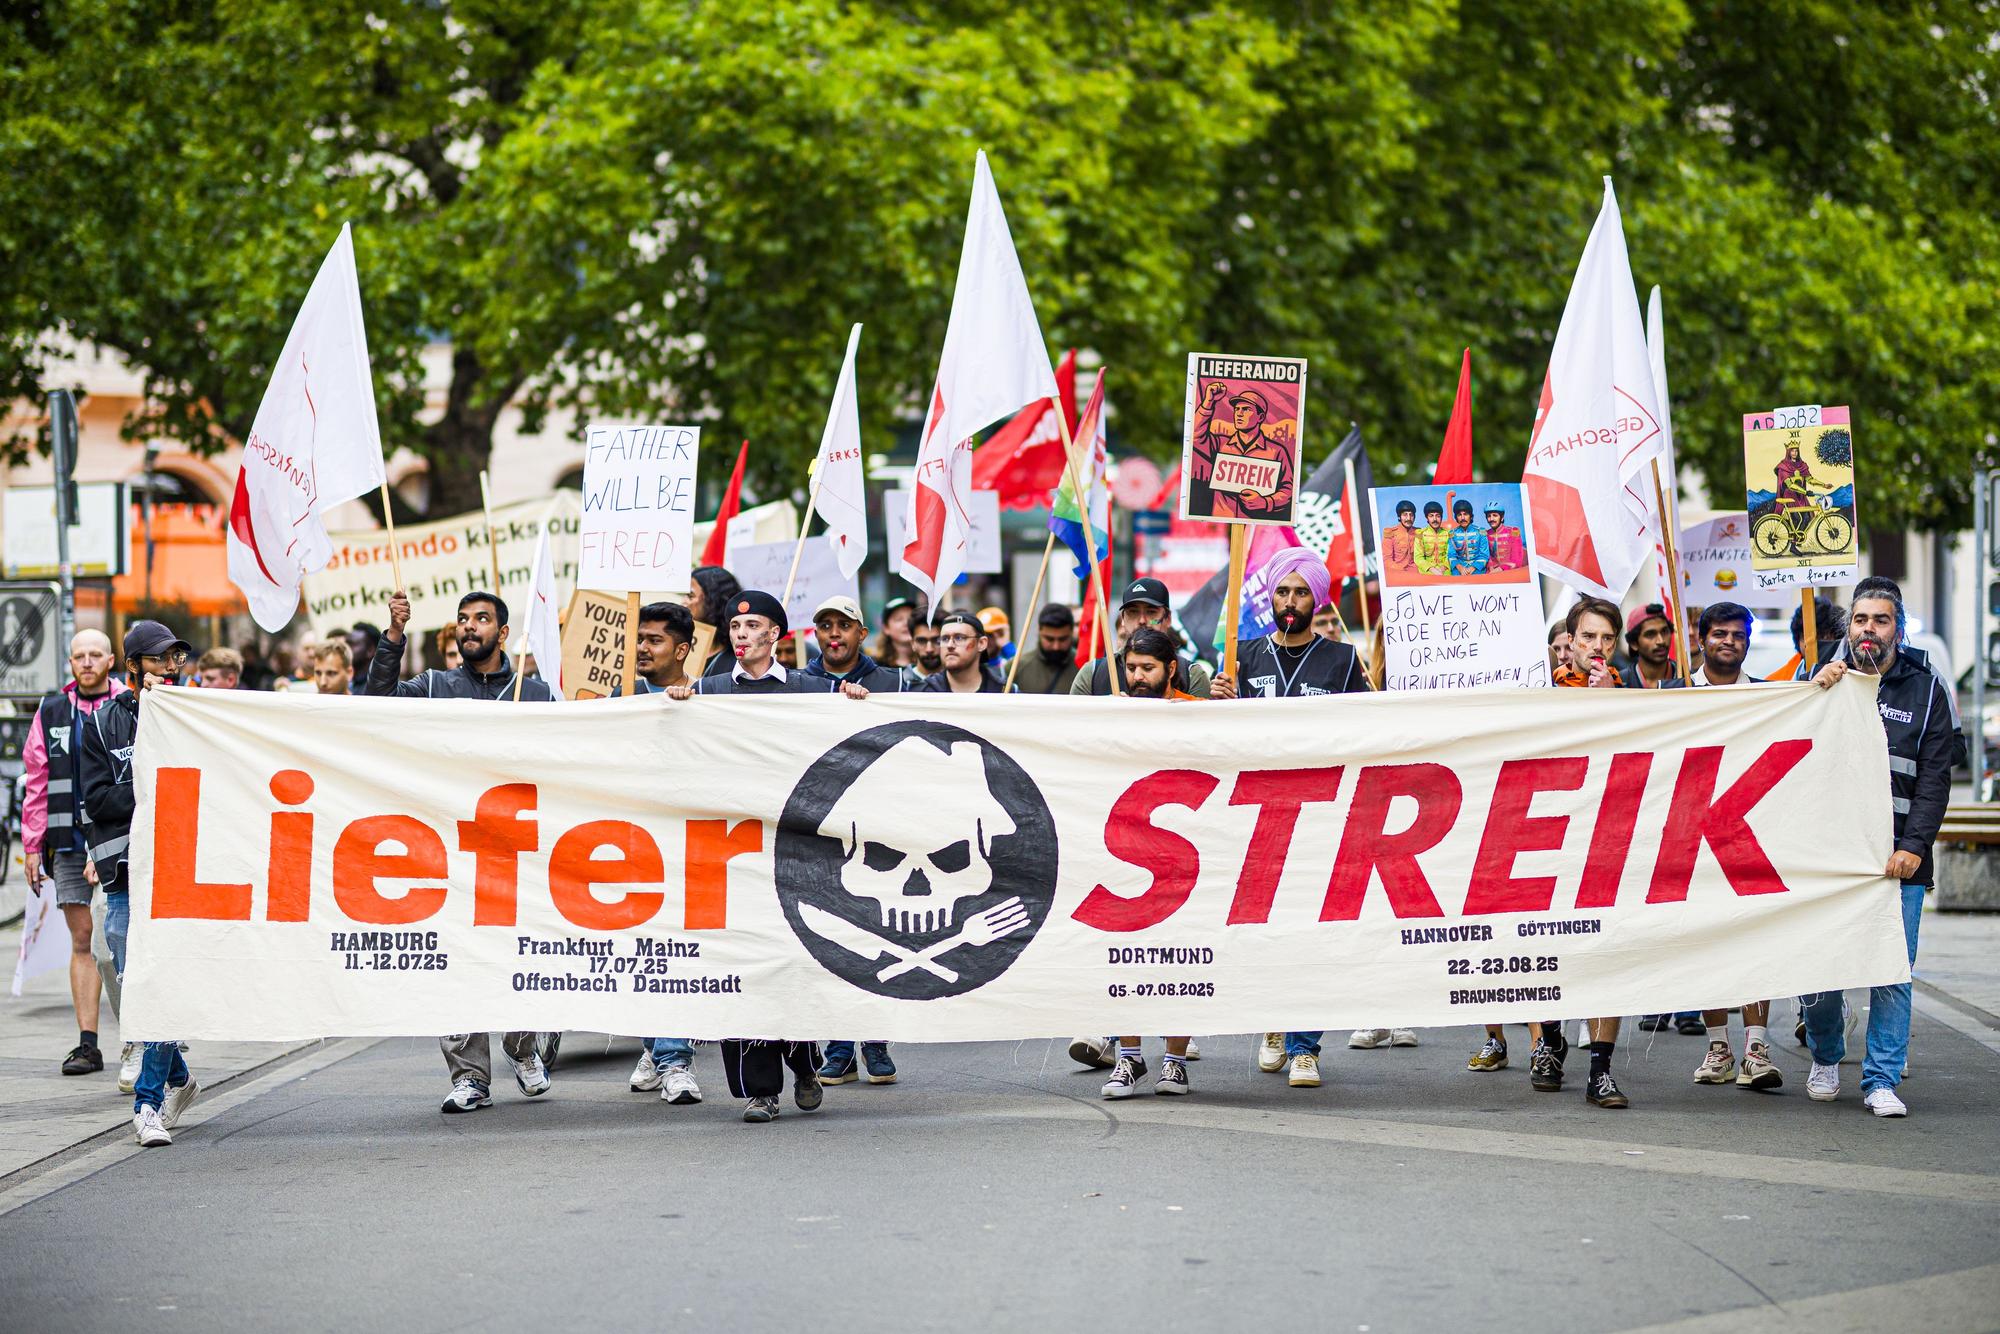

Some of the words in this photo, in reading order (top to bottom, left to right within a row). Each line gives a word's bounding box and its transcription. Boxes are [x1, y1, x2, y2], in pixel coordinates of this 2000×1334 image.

[1200, 359, 1298, 381] LIEFERANDO
[589, 428, 694, 463] FATHER
[1215, 460, 1277, 489] STREIK
[584, 475, 650, 512] WILL
[657, 475, 692, 512] BE
[547, 516, 579, 534] ou
[582, 530, 675, 569] FIRED
[1757, 570, 1794, 589] Karten
[311, 584, 424, 615] workes
[432, 575, 457, 595] in
[1419, 594, 1453, 616] WE
[1469, 593, 1519, 613] WON'T
[584, 601, 627, 629] YOUR
[590, 626, 608, 643] IS
[1386, 623, 1430, 645] RIDE
[1443, 621, 1470, 641] FOR
[1478, 619, 1501, 637] AN
[583, 644, 611, 664] MY
[1410, 642, 1478, 668] ORANGE
[588, 666, 622, 690] BRO
[1256, 676, 1276, 687] NGG
[1887, 711, 1911, 722] LIMIT
[151, 767, 763, 930] Liefer
[1070, 739, 1812, 932] STREIK
[330, 931, 438, 951] HAMBURG
[1401, 924, 1493, 945] HANNOVER
[1517, 919, 1601, 937] GÖTTINGEN
[518, 936, 614, 956] Frankfurt
[635, 938, 700, 957] Mainz
[1108, 947, 1214, 964] DORTMUND
[345, 953, 448, 970] 11.-12.07.25
[589, 956, 668, 974] 17.07.25
[1447, 956, 1558, 975] 22.-23.08.25
[512, 972, 618, 992] Offenbach
[633, 974, 742, 994] Darmstadt
[1108, 982, 1215, 997] 05.-07.08.2025
[1449, 986, 1561, 1005] BRAUNSCHWEIG
